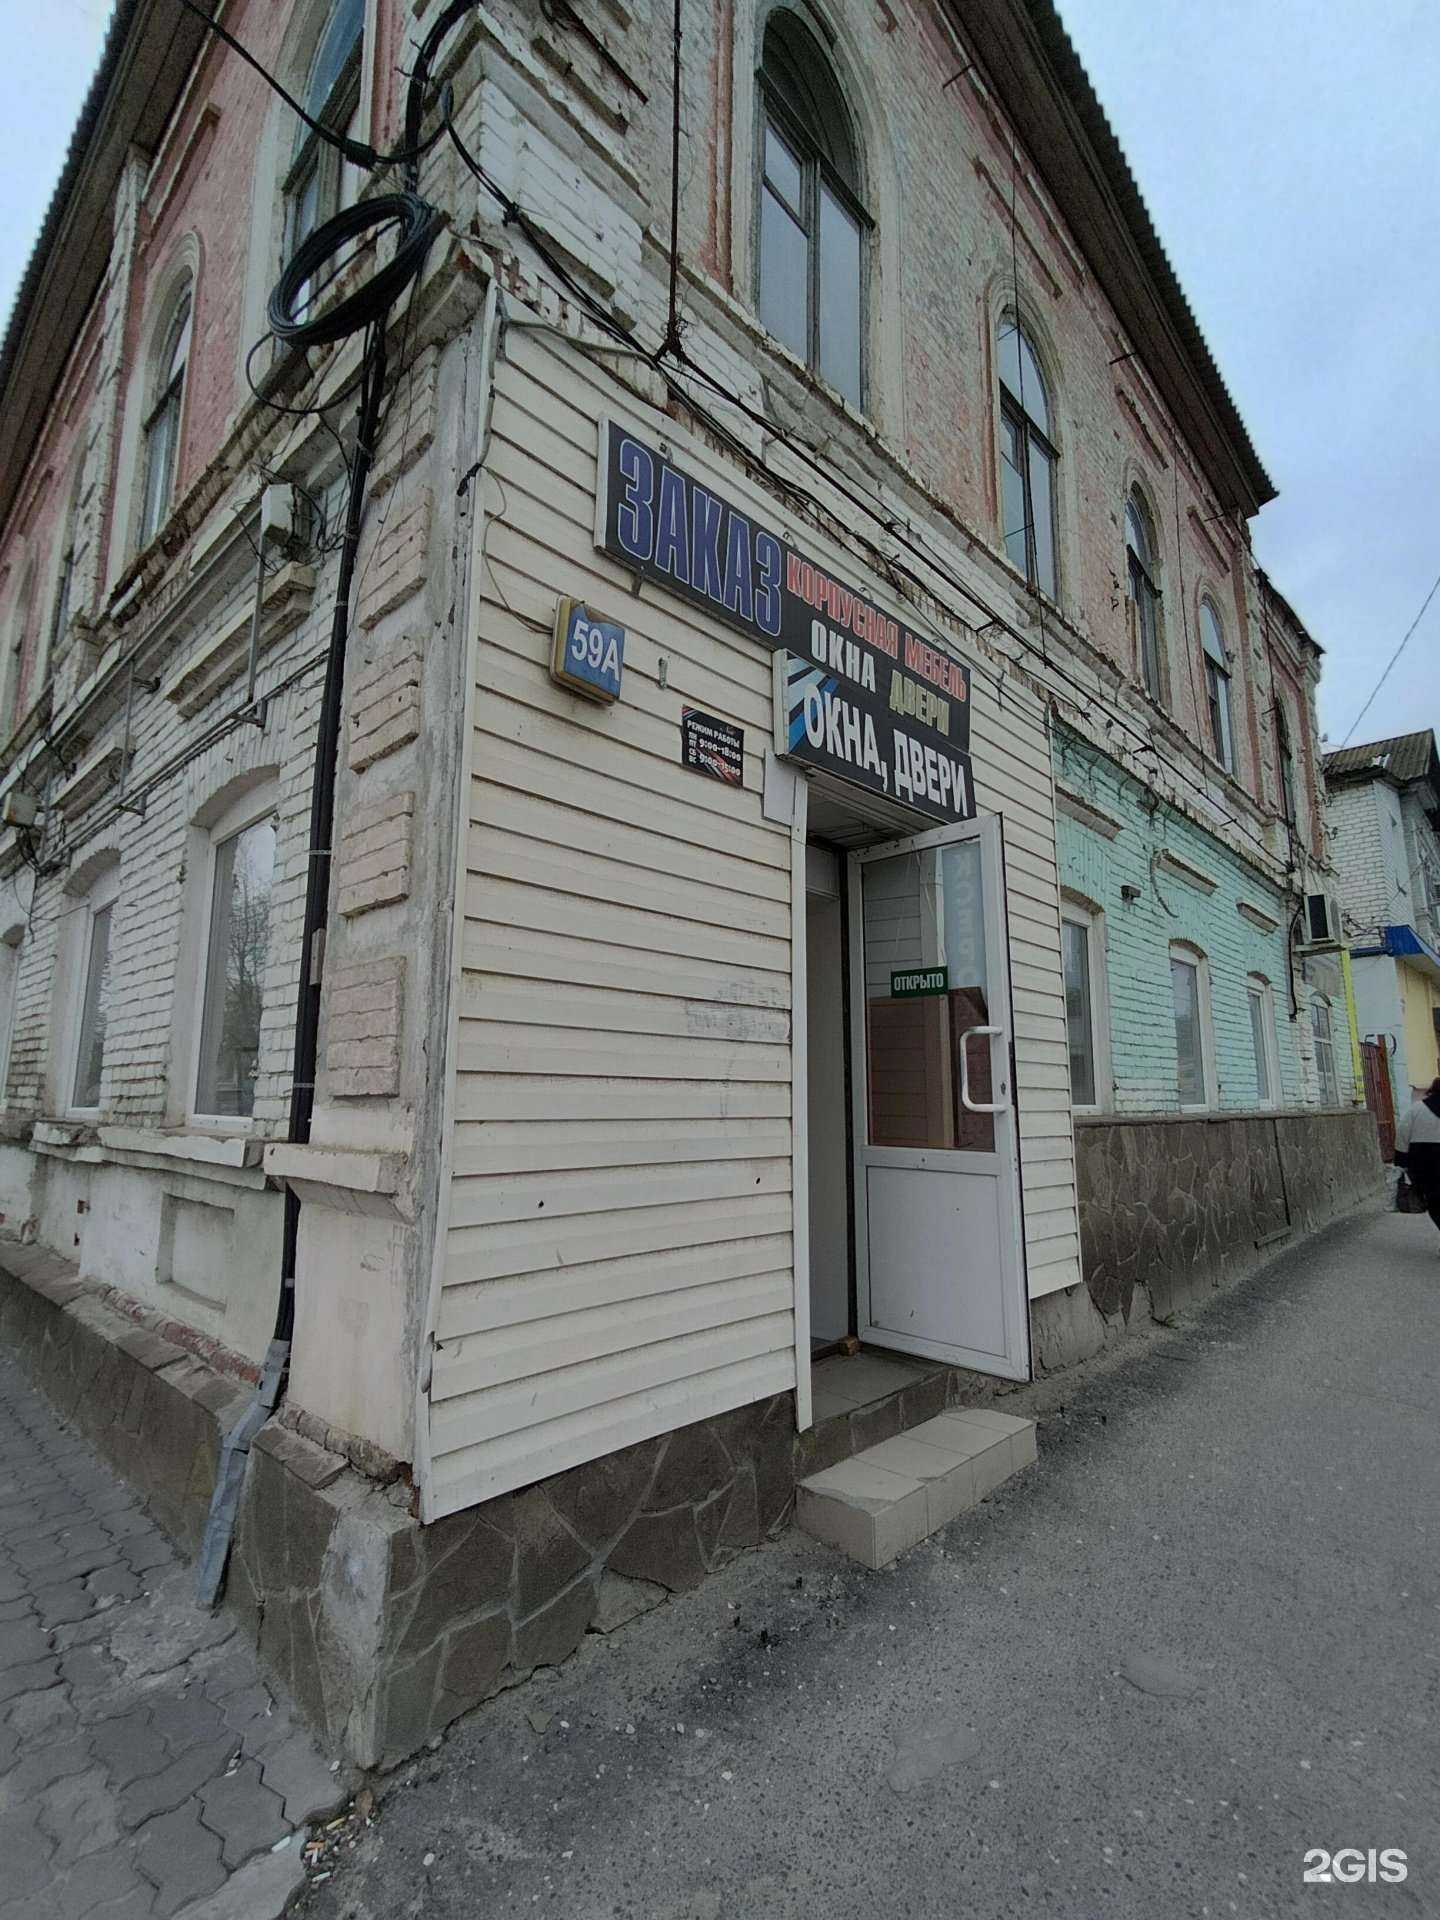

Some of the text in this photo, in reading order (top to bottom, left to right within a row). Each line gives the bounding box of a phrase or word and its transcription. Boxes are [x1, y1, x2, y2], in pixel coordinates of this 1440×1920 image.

[618, 438, 782, 637] ЗАКАЗ
[571, 619, 620, 682] 59А
[786, 550, 967, 703] КОРПУСНАЯ МЕБЕЛЬ
[811, 619, 950, 737] ОКНА ДВЕРИ
[687, 720, 740, 748] РЕЖИМ РАБОТЫ
[803, 682, 968, 818] ОКНА, ДВЕРИ
[894, 972, 944, 991] ОТКРЫТО
